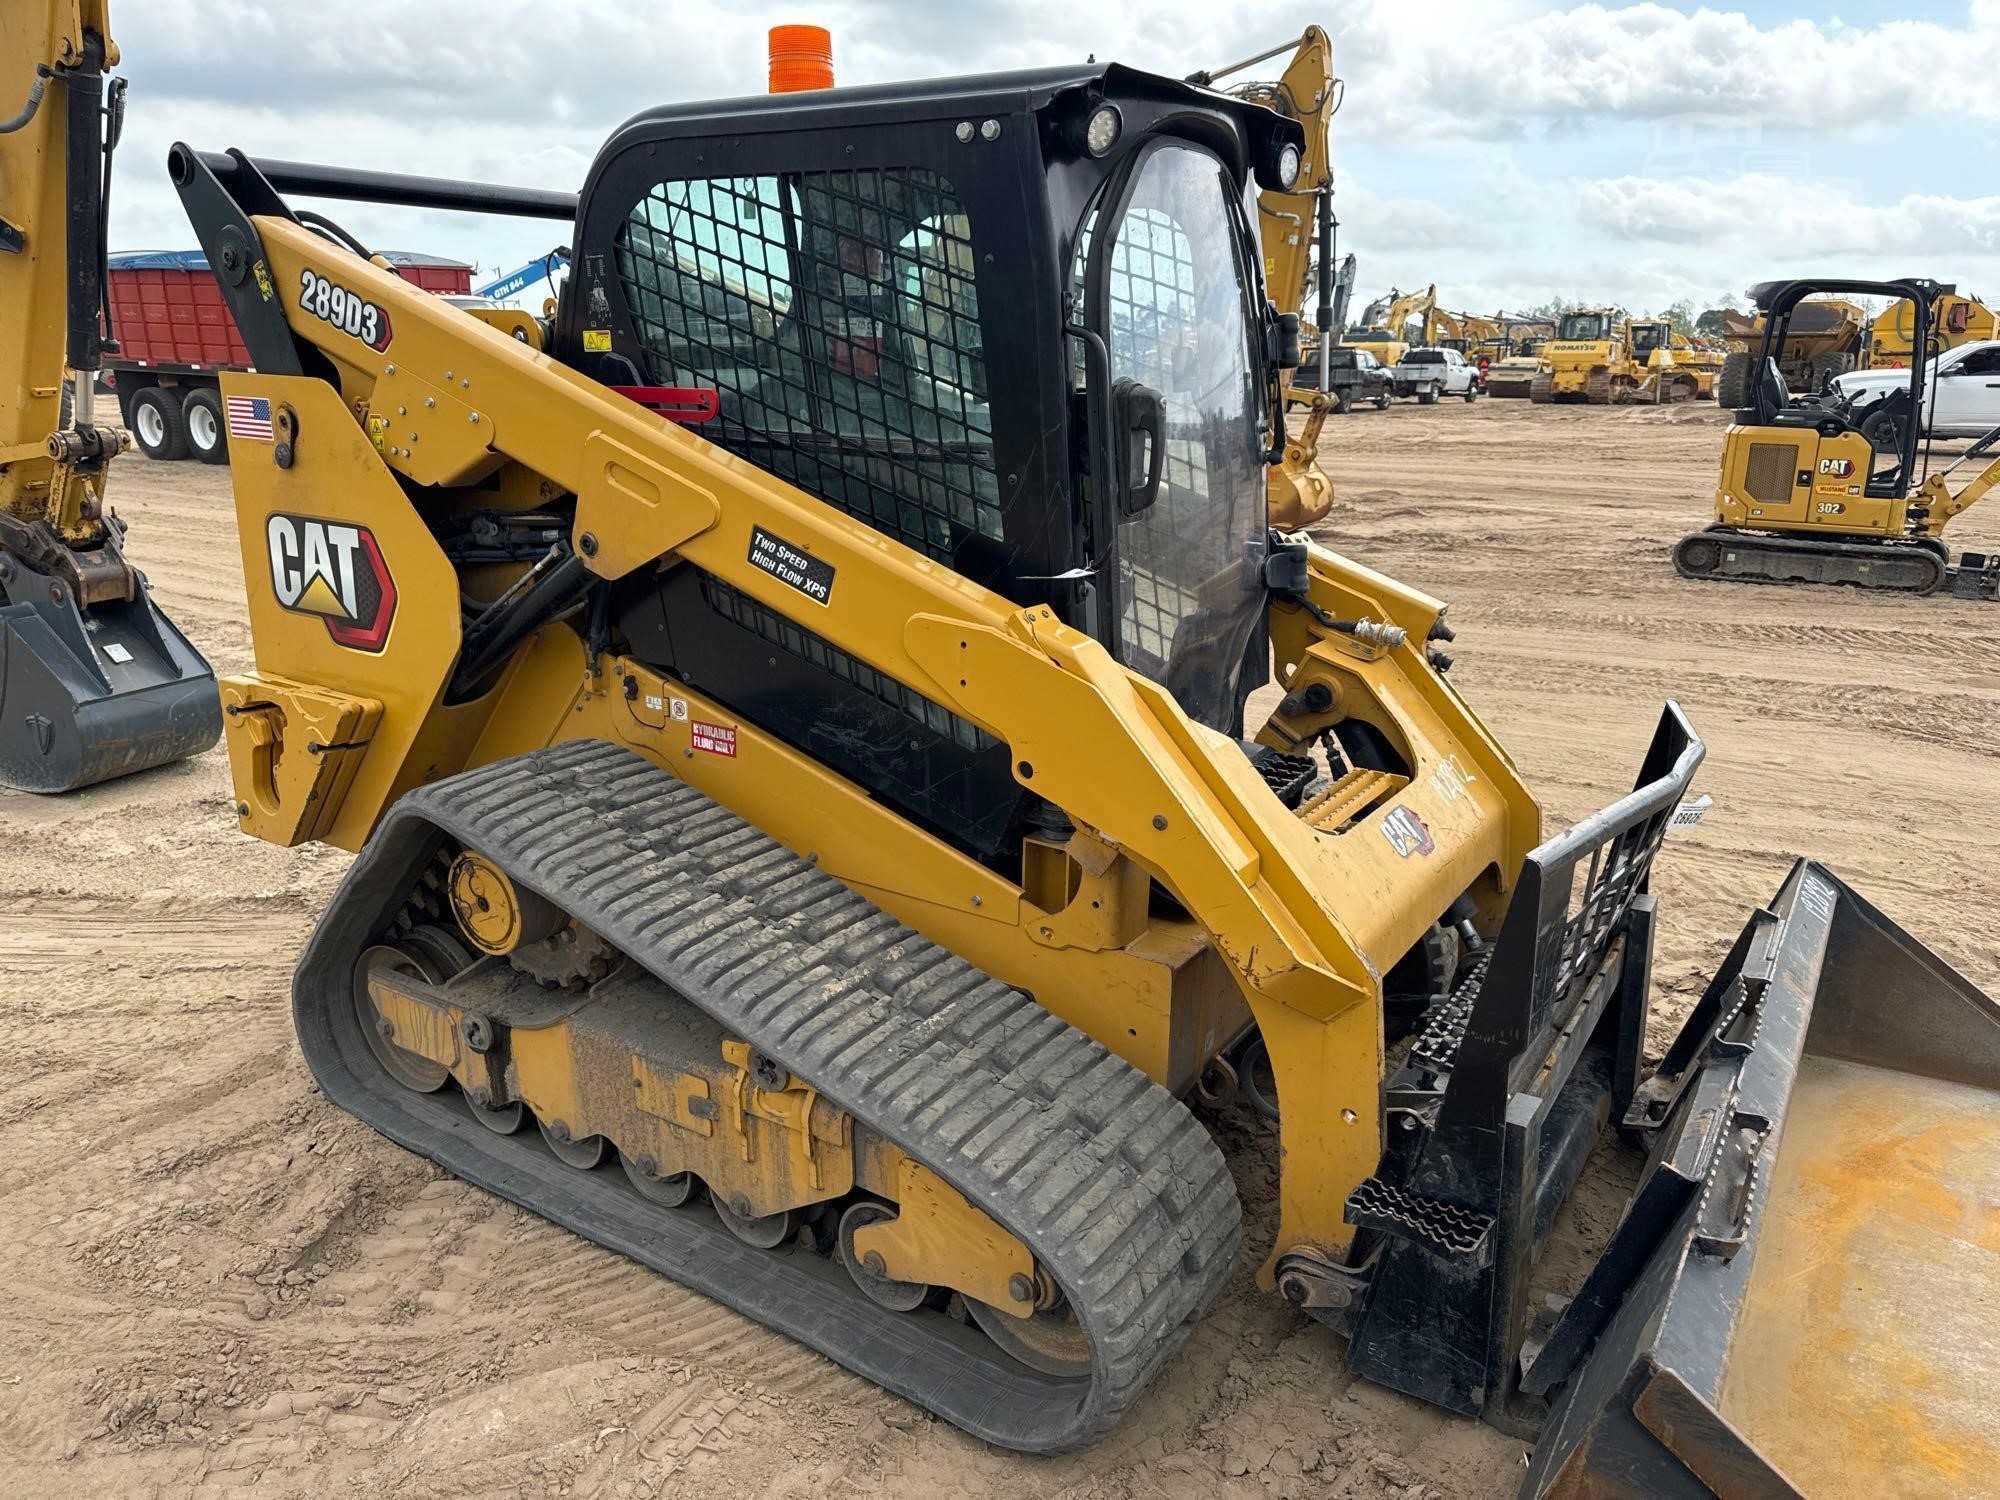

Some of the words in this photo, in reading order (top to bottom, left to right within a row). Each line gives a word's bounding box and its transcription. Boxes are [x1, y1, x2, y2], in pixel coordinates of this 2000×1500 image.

[493, 284, 510, 299] GTH
[509, 276, 524, 291] 844
[300, 270, 379, 345] 289D3
[1553, 343, 1597, 351] KOMATSU
[1820, 459, 1848, 475] CAT
[1817, 502, 1840, 514] 302
[267, 515, 360, 620] CAT
[803, 577, 827, 599] XPS
[692, 721, 735, 742] HYDRAULIC
[693, 735, 714, 750] FLUID
[714, 741, 735, 755] ONLY
[1380, 807, 1423, 857] CAT
[1800, 874, 1835, 924] 192892
